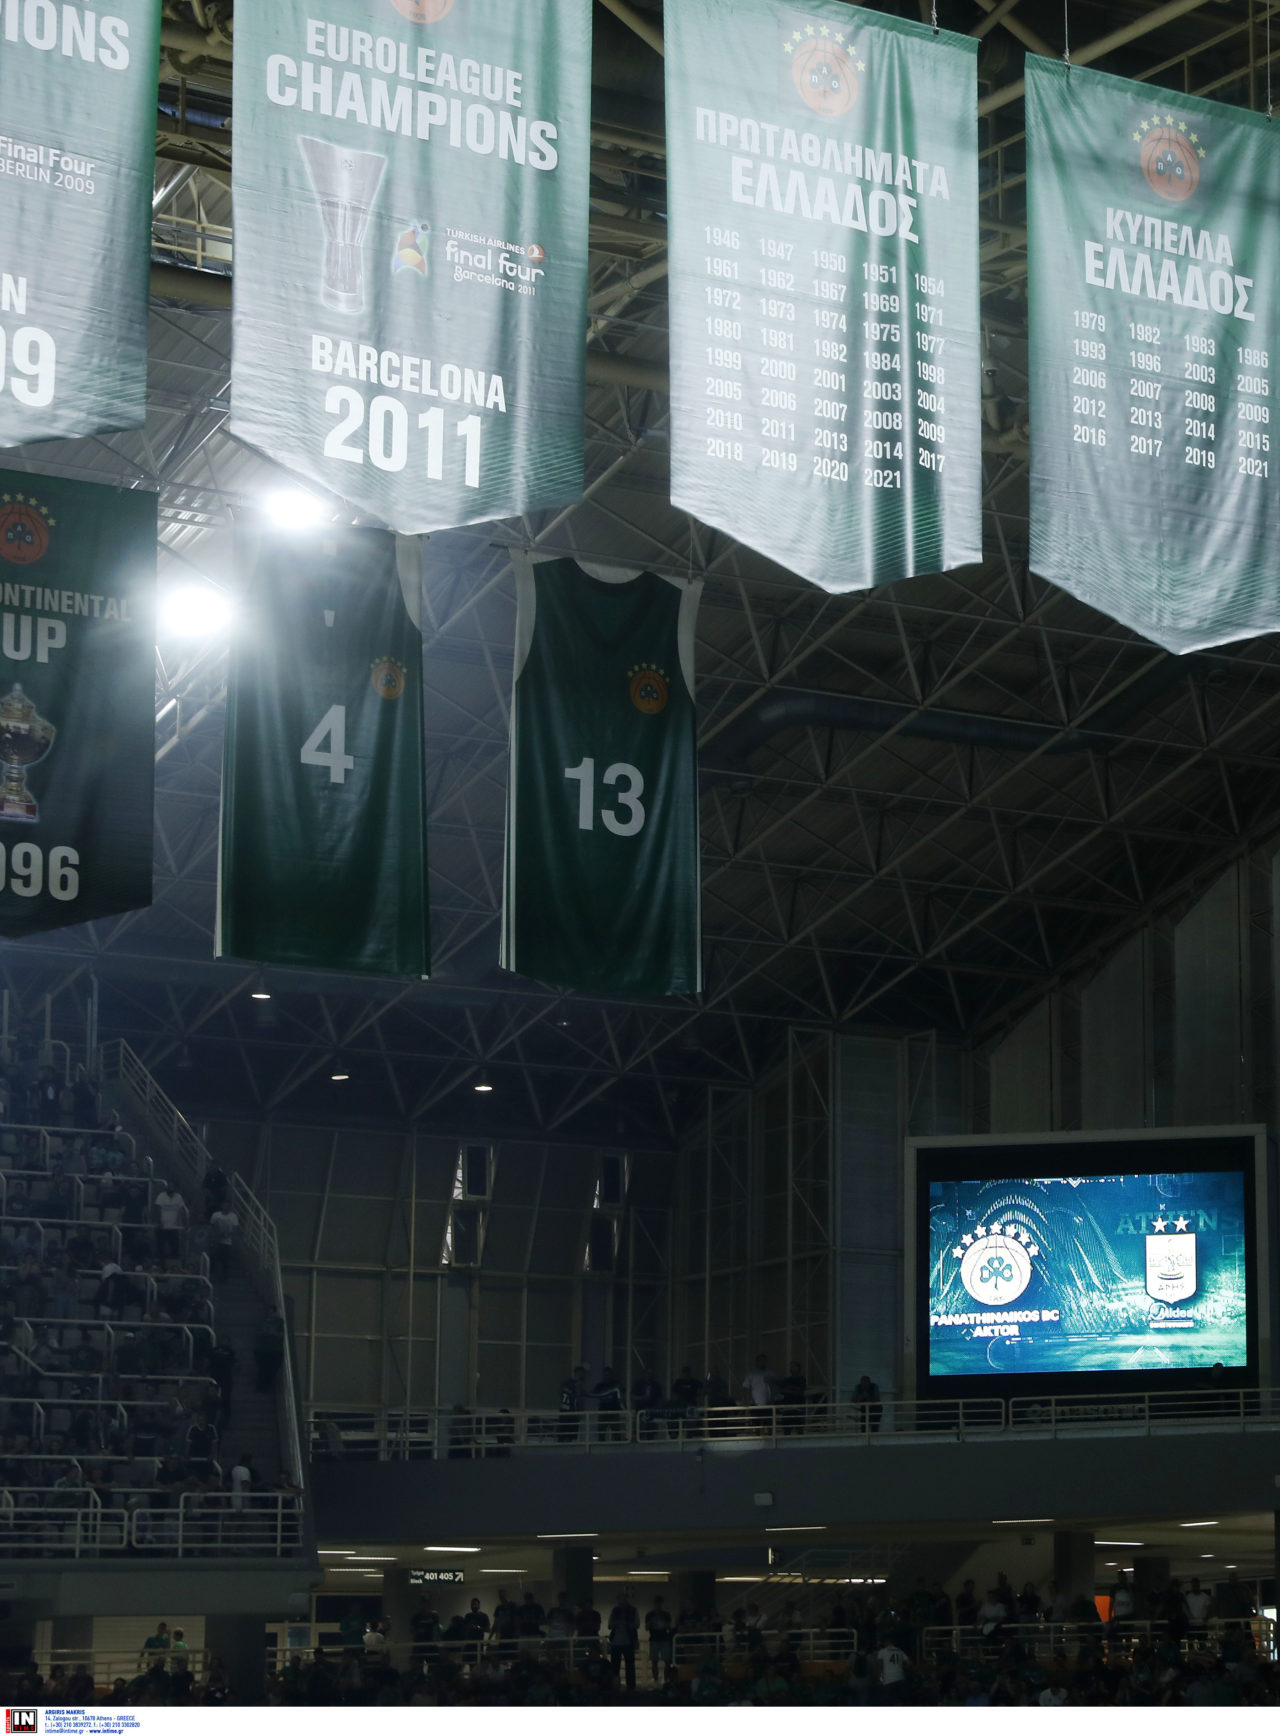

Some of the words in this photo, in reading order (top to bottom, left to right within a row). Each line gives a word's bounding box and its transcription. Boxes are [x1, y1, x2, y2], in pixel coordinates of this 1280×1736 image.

[0, 0, 130, 70] IONS
[306, 18, 522, 108] EUROLEAGUE
[266, 54, 559, 171] CHAMPIONS
[49, 146, 96, 177] Four
[54, 171, 95, 195] 2009
[696, 106, 951, 201] ΠΡΩΤΑΘΛΗΜΑΤΑ
[731, 155, 920, 245] ΕΛΛΑΔΟΣ
[446, 227, 486, 245] TURKISH
[486, 238, 525, 255] AIRLINES
[446, 239, 492, 271] final
[499, 252, 545, 282] four
[705, 226, 740, 250] 1946
[760, 238, 793, 261] 1947
[812, 250, 846, 273] 1950
[863, 262, 897, 283] 1951
[915, 272, 944, 296] 1954
[1106, 207, 1234, 267] ΚΥΠΕΛΛΑ
[453, 266, 515, 291] Barcelona
[517, 284, 536, 296] 2011
[705, 256, 739, 280] 1961
[760, 268, 794, 291] 1962
[813, 280, 846, 303] 1967
[863, 292, 899, 313] 1969
[915, 302, 943, 326] 1971
[1085, 240, 1255, 322] ΕΛΛΑΔΟΣ
[705, 286, 741, 310] 1972
[760, 298, 795, 321] 1973
[813, 309, 846, 332] 1974
[863, 321, 900, 342] 1975
[916, 331, 945, 355] 1977
[706, 316, 741, 340] 1980
[761, 328, 794, 351] 1981
[814, 339, 847, 362] 1982
[864, 352, 900, 372] 1984
[917, 361, 945, 385] 1998
[1074, 311, 1105, 332] 1979
[1129, 323, 1160, 344] 1982
[1185, 335, 1215, 356] 1983
[1237, 347, 1268, 368] 1986
[0, 325, 56, 407] 9
[311, 334, 507, 413] BARCELONA
[706, 347, 741, 370] 1999
[761, 358, 795, 381] 2000
[814, 369, 846, 392] 2001
[864, 380, 901, 401] 2003
[917, 389, 945, 414] 2004
[1073, 367, 1106, 389] 2006
[1130, 379, 1161, 400] 2007
[1185, 390, 1215, 412] 2008
[1238, 403, 1269, 424] 2009
[1074, 338, 1106, 361] 1993
[1130, 351, 1161, 373] 1996
[1185, 362, 1215, 384] 2003
[1237, 375, 1269, 396] 2005
[323, 385, 482, 488] 2011
[706, 377, 741, 400] 2005
[762, 388, 796, 411] 2006
[814, 398, 847, 422] 2007
[864, 410, 902, 430] 2008
[918, 418, 945, 443] 2009
[706, 407, 742, 431] 2010
[762, 418, 795, 441] 2011
[814, 428, 847, 452] 2013
[865, 440, 903, 460] 2014
[919, 448, 945, 472] 2017
[1074, 396, 1106, 418] 2012
[1130, 407, 1162, 429] 2013
[1185, 418, 1215, 441] 2014
[1238, 430, 1269, 452] 2015
[706, 438, 742, 461] 2018
[762, 448, 797, 471] 2019
[813, 457, 848, 481] 2020
[865, 469, 900, 488] 2021
[1074, 425, 1106, 447] 2016
[1131, 436, 1162, 457] 2017
[1185, 447, 1215, 469] 2019
[1239, 457, 1268, 478] 2021
[0, 582, 132, 622] NTINENTAL
[2, 612, 67, 664] UP
[301, 704, 354, 784] 4
[564, 757, 646, 837] 13
[0, 841, 80, 901] 96
[930, 1310, 1040, 1326] PANATHINAIKOS
[1041, 1309, 1059, 1322] BC
[973, 1324, 1020, 1338] AKTOR
[424, 1572, 438, 1581] 401
[438, 1572, 454, 1581] 405
